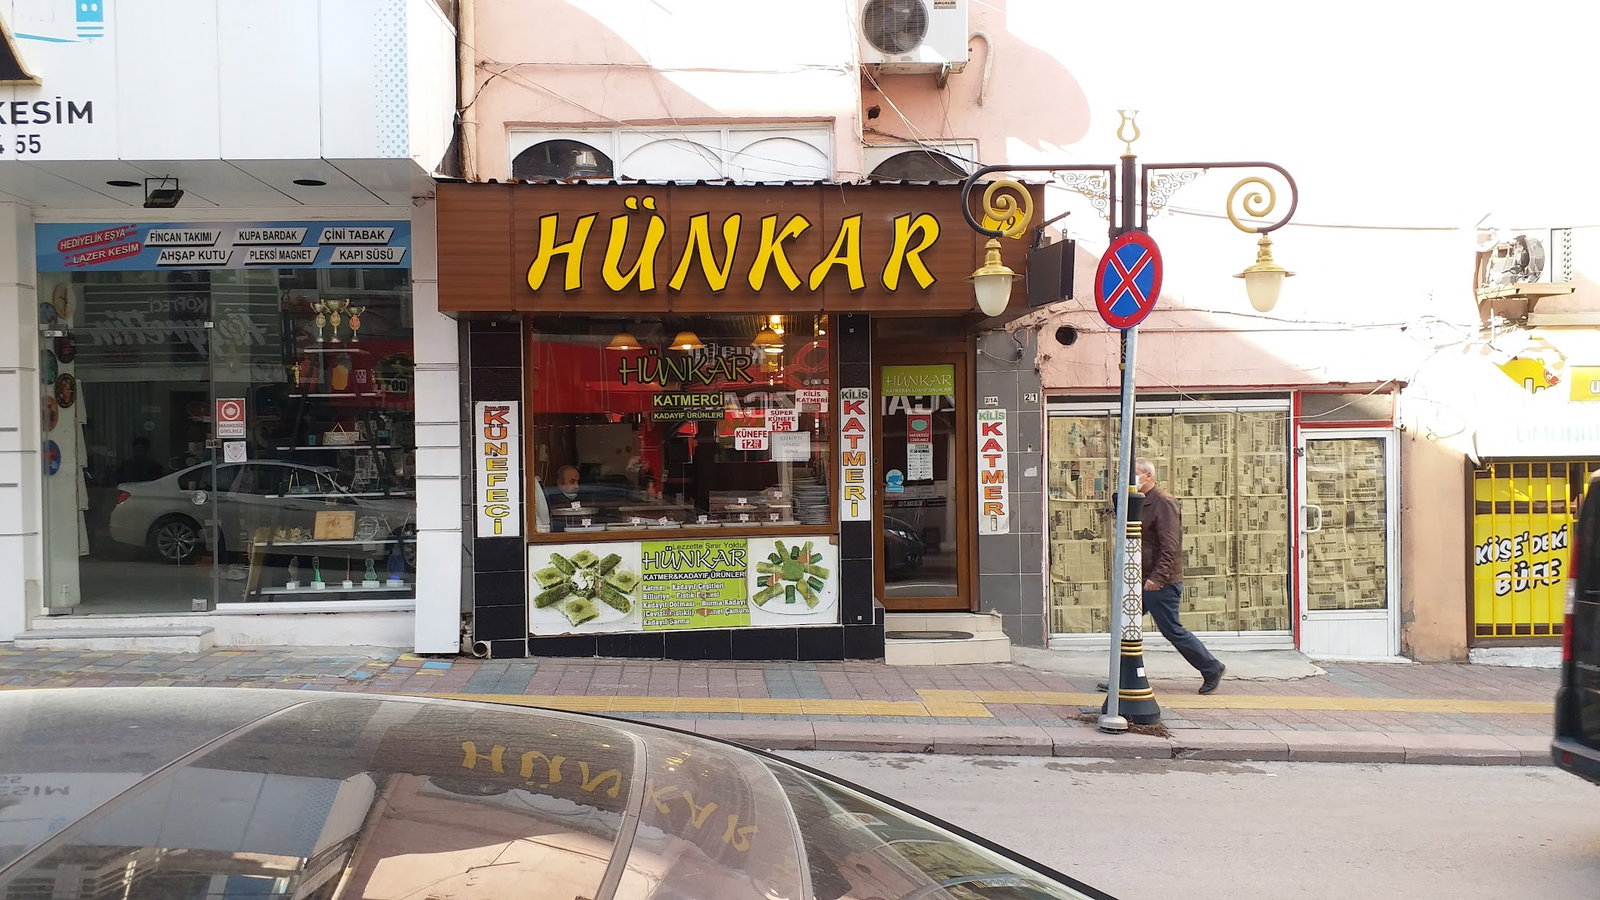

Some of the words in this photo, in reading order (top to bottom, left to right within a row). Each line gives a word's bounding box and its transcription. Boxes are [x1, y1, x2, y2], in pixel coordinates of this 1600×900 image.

[60, 232, 103, 250] HEDİYELİK
[104, 228, 126, 242] EŞYA
[150, 230, 182, 242] FİNCAN
[184, 231, 212, 242] TAKIMI
[239, 230, 261, 240] KUPA
[263, 230, 297, 240] BARDAK
[324, 228, 346, 242] ÇİNİ
[348, 230, 386, 240] TABAK
[526, 195, 941, 293] HÜNKAR
[73, 251, 106, 264] LAZER
[108, 243, 139, 257] KESİM
[160, 250, 195, 263] AHŞAP
[198, 250, 226, 261] KUTU
[250, 248, 278, 260] PLEKSİ
[278, 250, 311, 260] MAGNET
[339, 250, 364, 260] KAPI
[366, 248, 394, 260] SÜSÜ
[618, 349, 754, 387] HÜNKAR
[886, 373, 952, 388] HÜNKAR
[653, 391, 724, 407] KATMERCİ
[841, 389, 868, 399] KİLİS
[654, 411, 685, 420] KADAYIF
[686, 410, 724, 419] ÜRÜNLERİ
[979, 410, 1005, 421] KİLİS
[735, 428, 768, 438] KÜNEFE
[842, 400, 866, 517] KATMERİ
[981, 422, 1005, 531] KATMERİ
[642, 546, 747, 570] HÜNKAR
[643, 571, 709, 581] KATMER&KADAYIF
[1495, 558, 1563, 596] BÜFE
